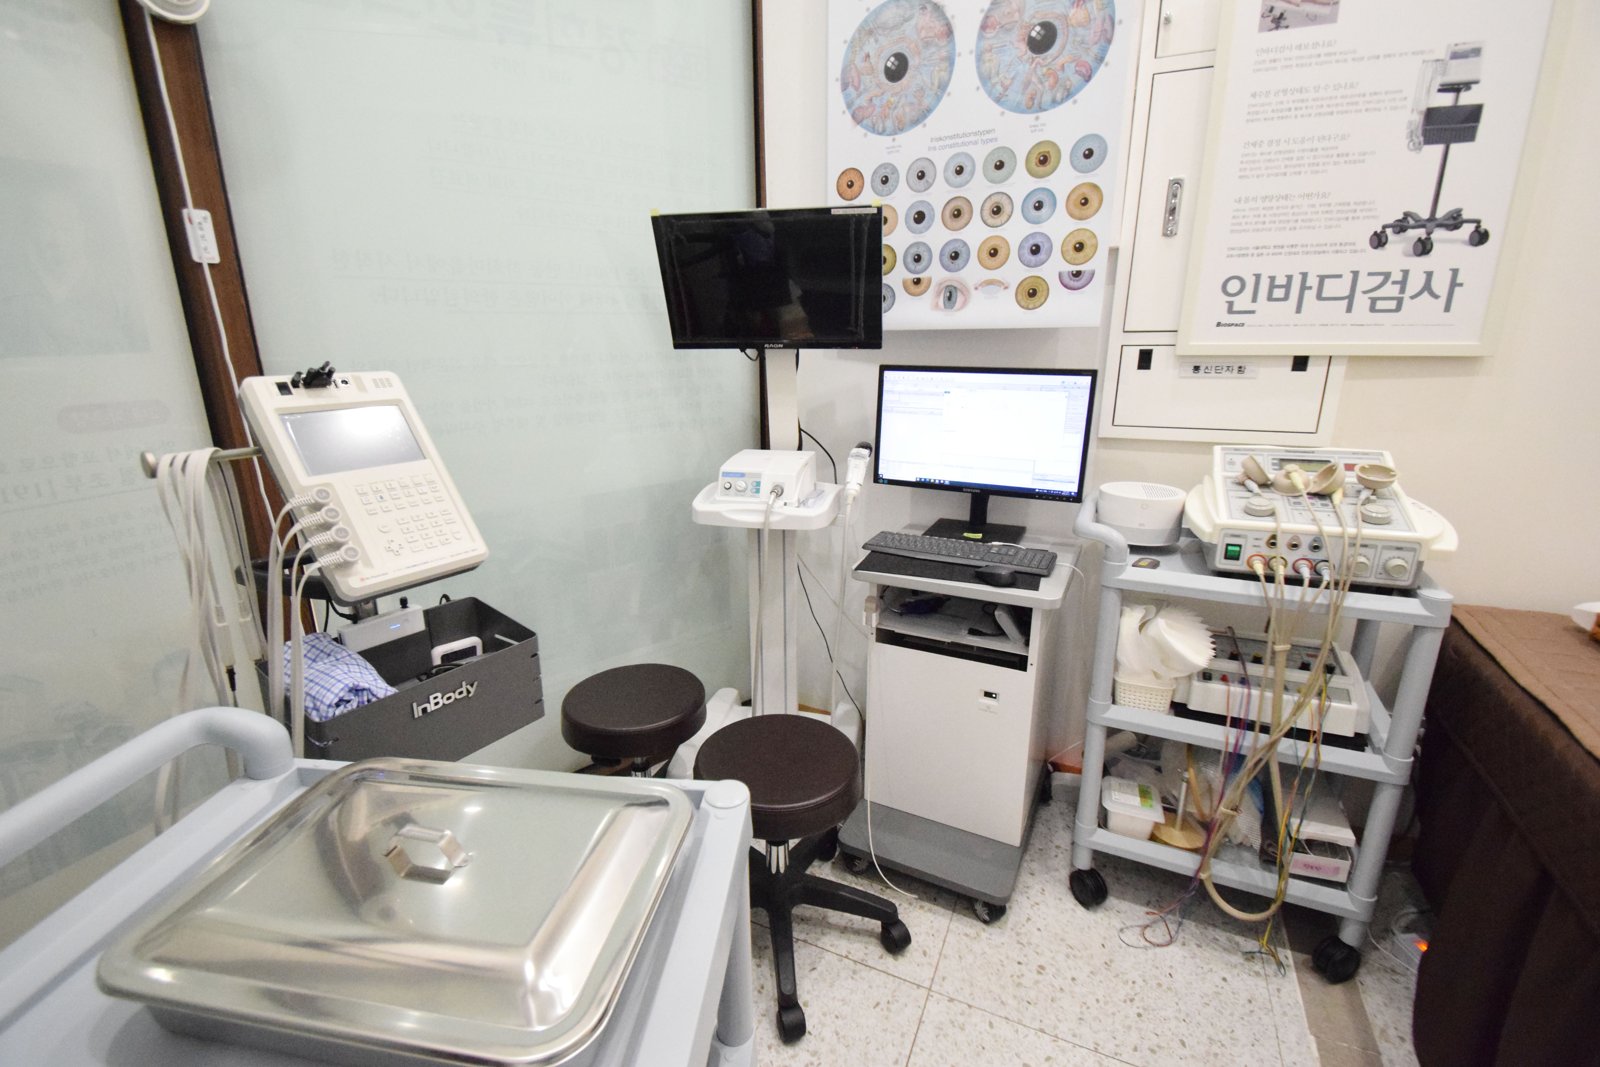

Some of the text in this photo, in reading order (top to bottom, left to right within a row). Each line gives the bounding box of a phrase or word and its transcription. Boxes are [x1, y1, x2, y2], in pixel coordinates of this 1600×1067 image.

[938, 140, 979, 151] constitutional
[980, 136, 998, 146] types
[1220, 267, 1464, 315] 인바디검사
[1191, 364, 1247, 376] 통신단자함
[412, 680, 479, 719] InBody
